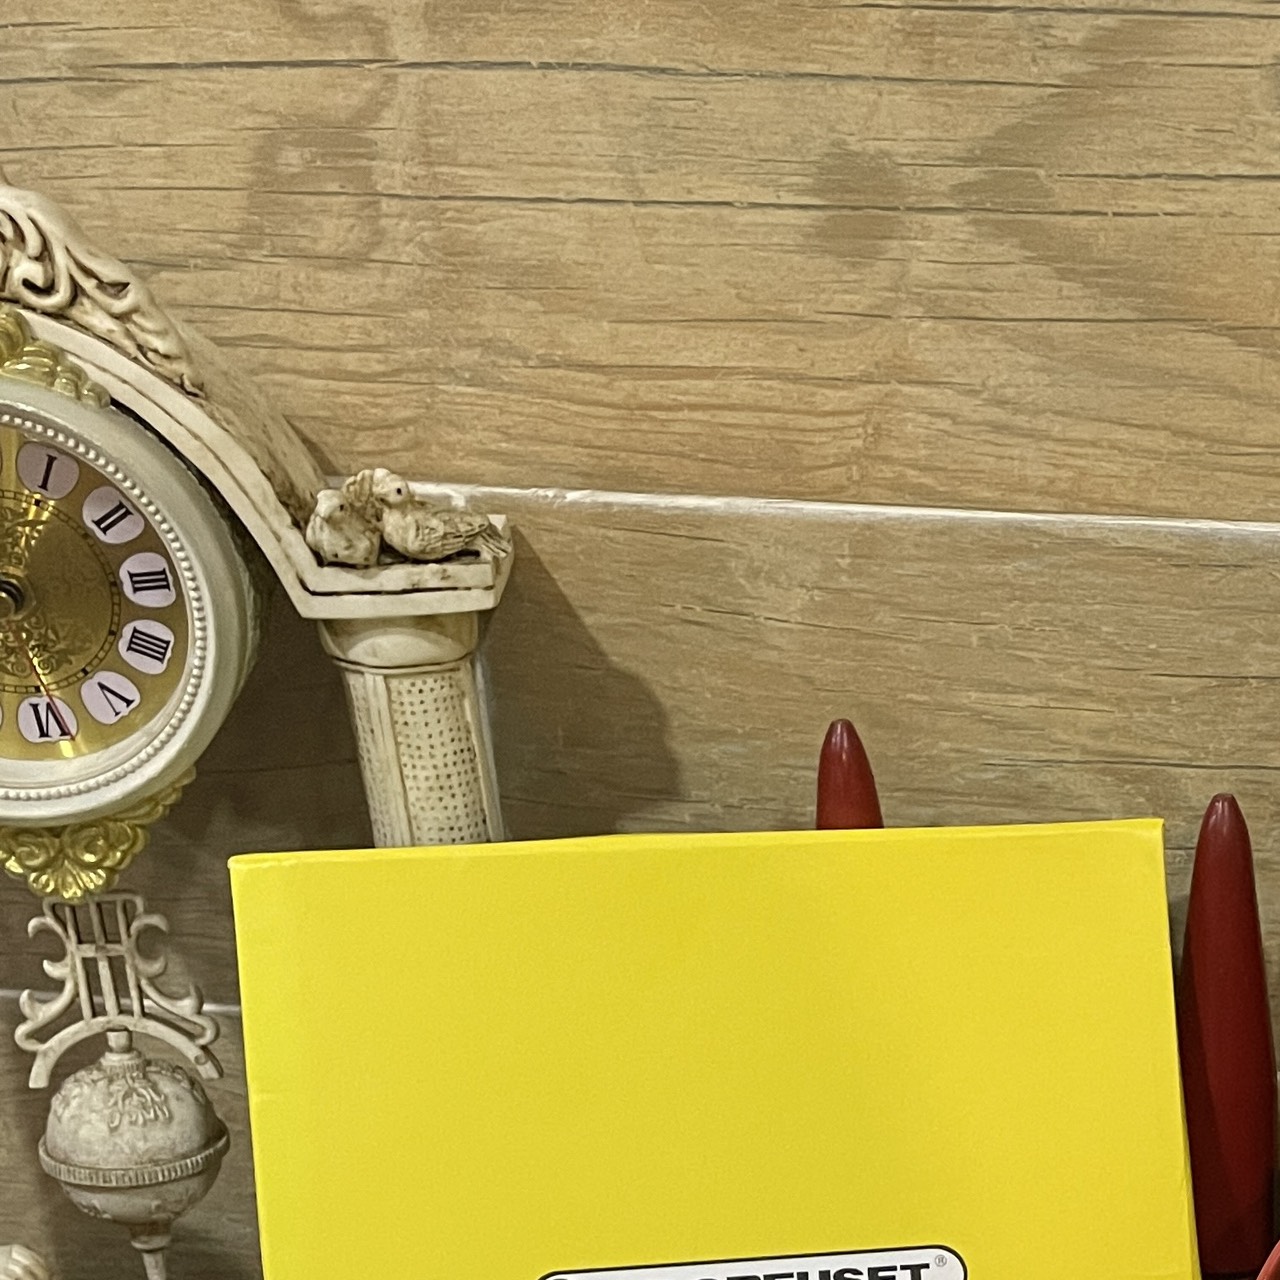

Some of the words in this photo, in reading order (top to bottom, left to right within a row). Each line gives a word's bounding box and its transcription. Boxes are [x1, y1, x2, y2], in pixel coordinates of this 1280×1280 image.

[38, 454, 57, 491] I
[92, 501, 134, 535] II
[127, 568, 171, 593] III
[126, 626, 171, 663] IIII
[97, 681, 135, 716] V
